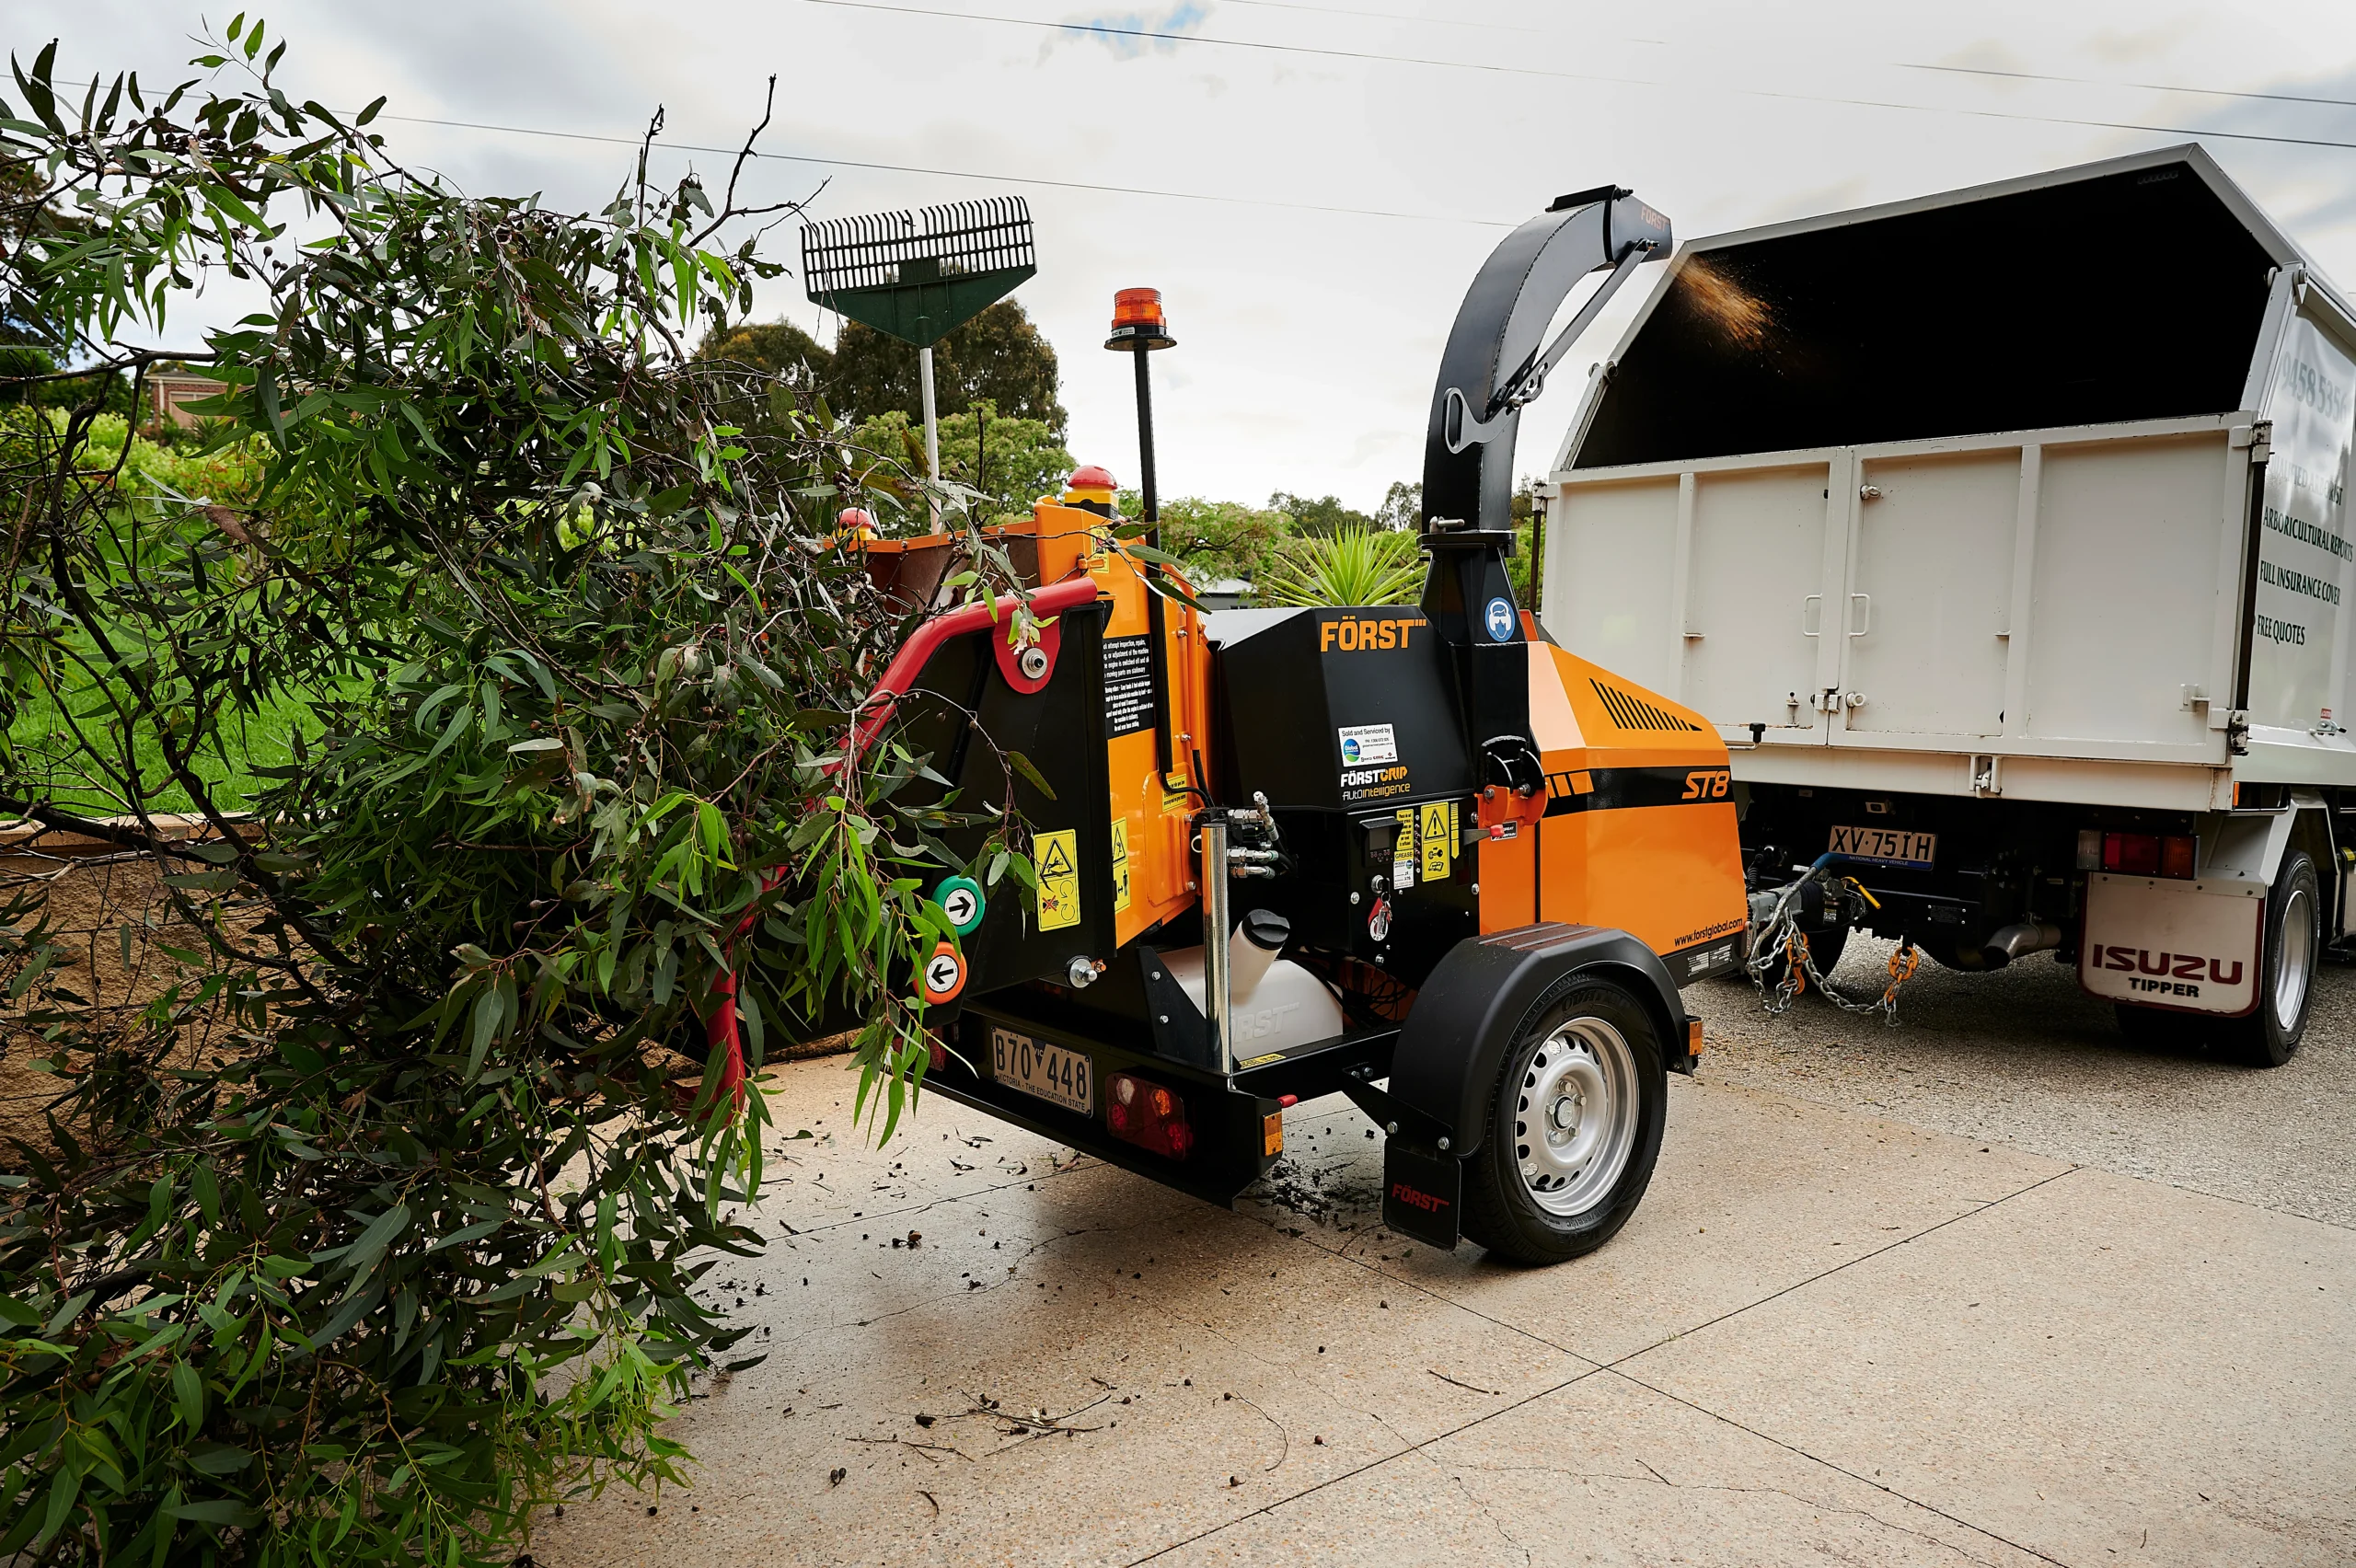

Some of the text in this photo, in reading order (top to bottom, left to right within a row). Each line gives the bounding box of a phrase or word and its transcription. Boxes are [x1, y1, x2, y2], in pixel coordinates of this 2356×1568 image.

[2281, 352, 2348, 424] 9458 5356
[2263, 507, 2353, 562] ARBORICULTURAL REPORTS
[2259, 560, 2340, 606] FULL INSURANCE COVER
[1321, 616, 1426, 651] FÖRST
[2258, 615, 2305, 645] FREE QUOTES
[1364, 727, 1383, 735] Serviced
[1681, 770, 1730, 800] ST8
[1674, 917, 1743, 947] www.forstglobal.com
[2093, 944, 2243, 986] ISUZU
[2129, 977, 2200, 997] TIPPER
[995, 1035, 1086, 1100] B70 448
[1034, 1047, 1044, 1057] VIC
[998, 1072, 1021, 1089] VICTORIA
[1025, 1082, 1035, 1094] THE
[1036, 1087, 1067, 1104] EDUCATION
[1068, 1098, 1085, 1112] STATE
[1392, 1183, 1449, 1213] FÖRST
